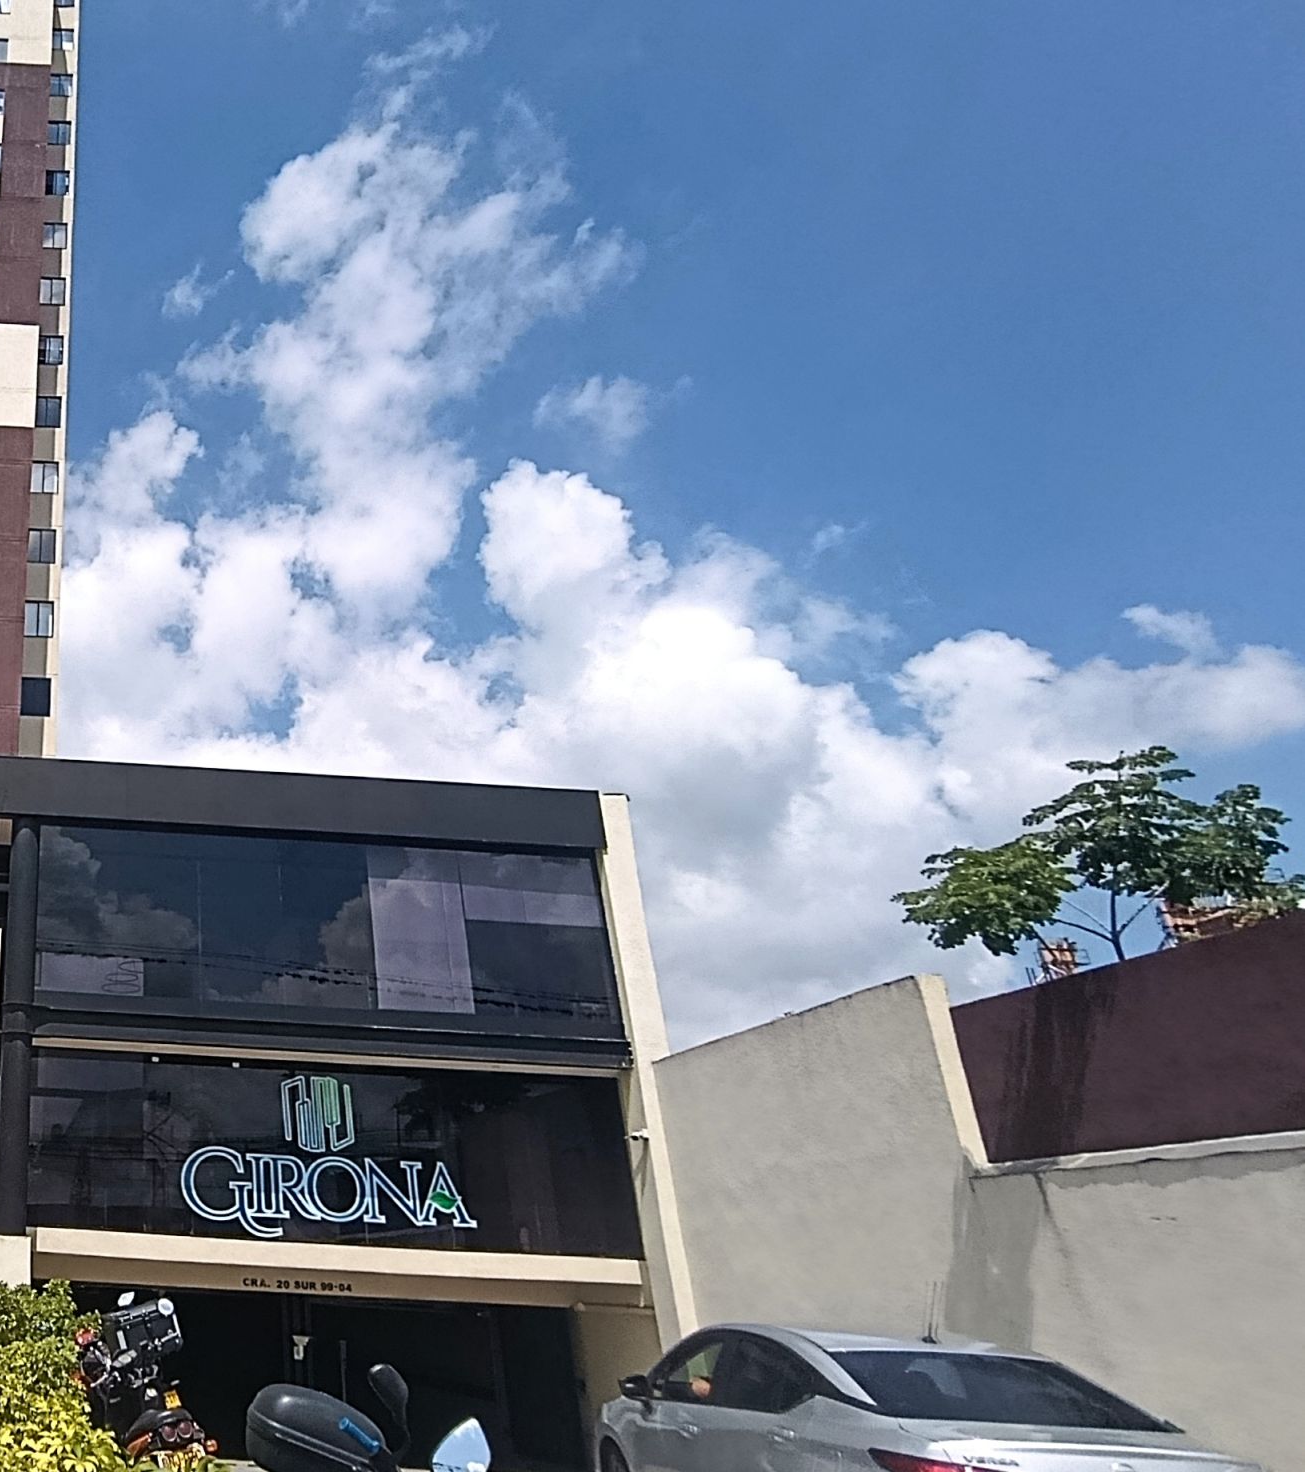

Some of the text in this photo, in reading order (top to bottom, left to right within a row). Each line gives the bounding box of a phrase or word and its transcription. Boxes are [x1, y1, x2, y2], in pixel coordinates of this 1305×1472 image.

[180, 1146, 477, 1238] GIRONA
[242, 1278, 271, 1288] CRA.
[276, 1280, 290, 1290] 20
[294, 1280, 317, 1291] SUR
